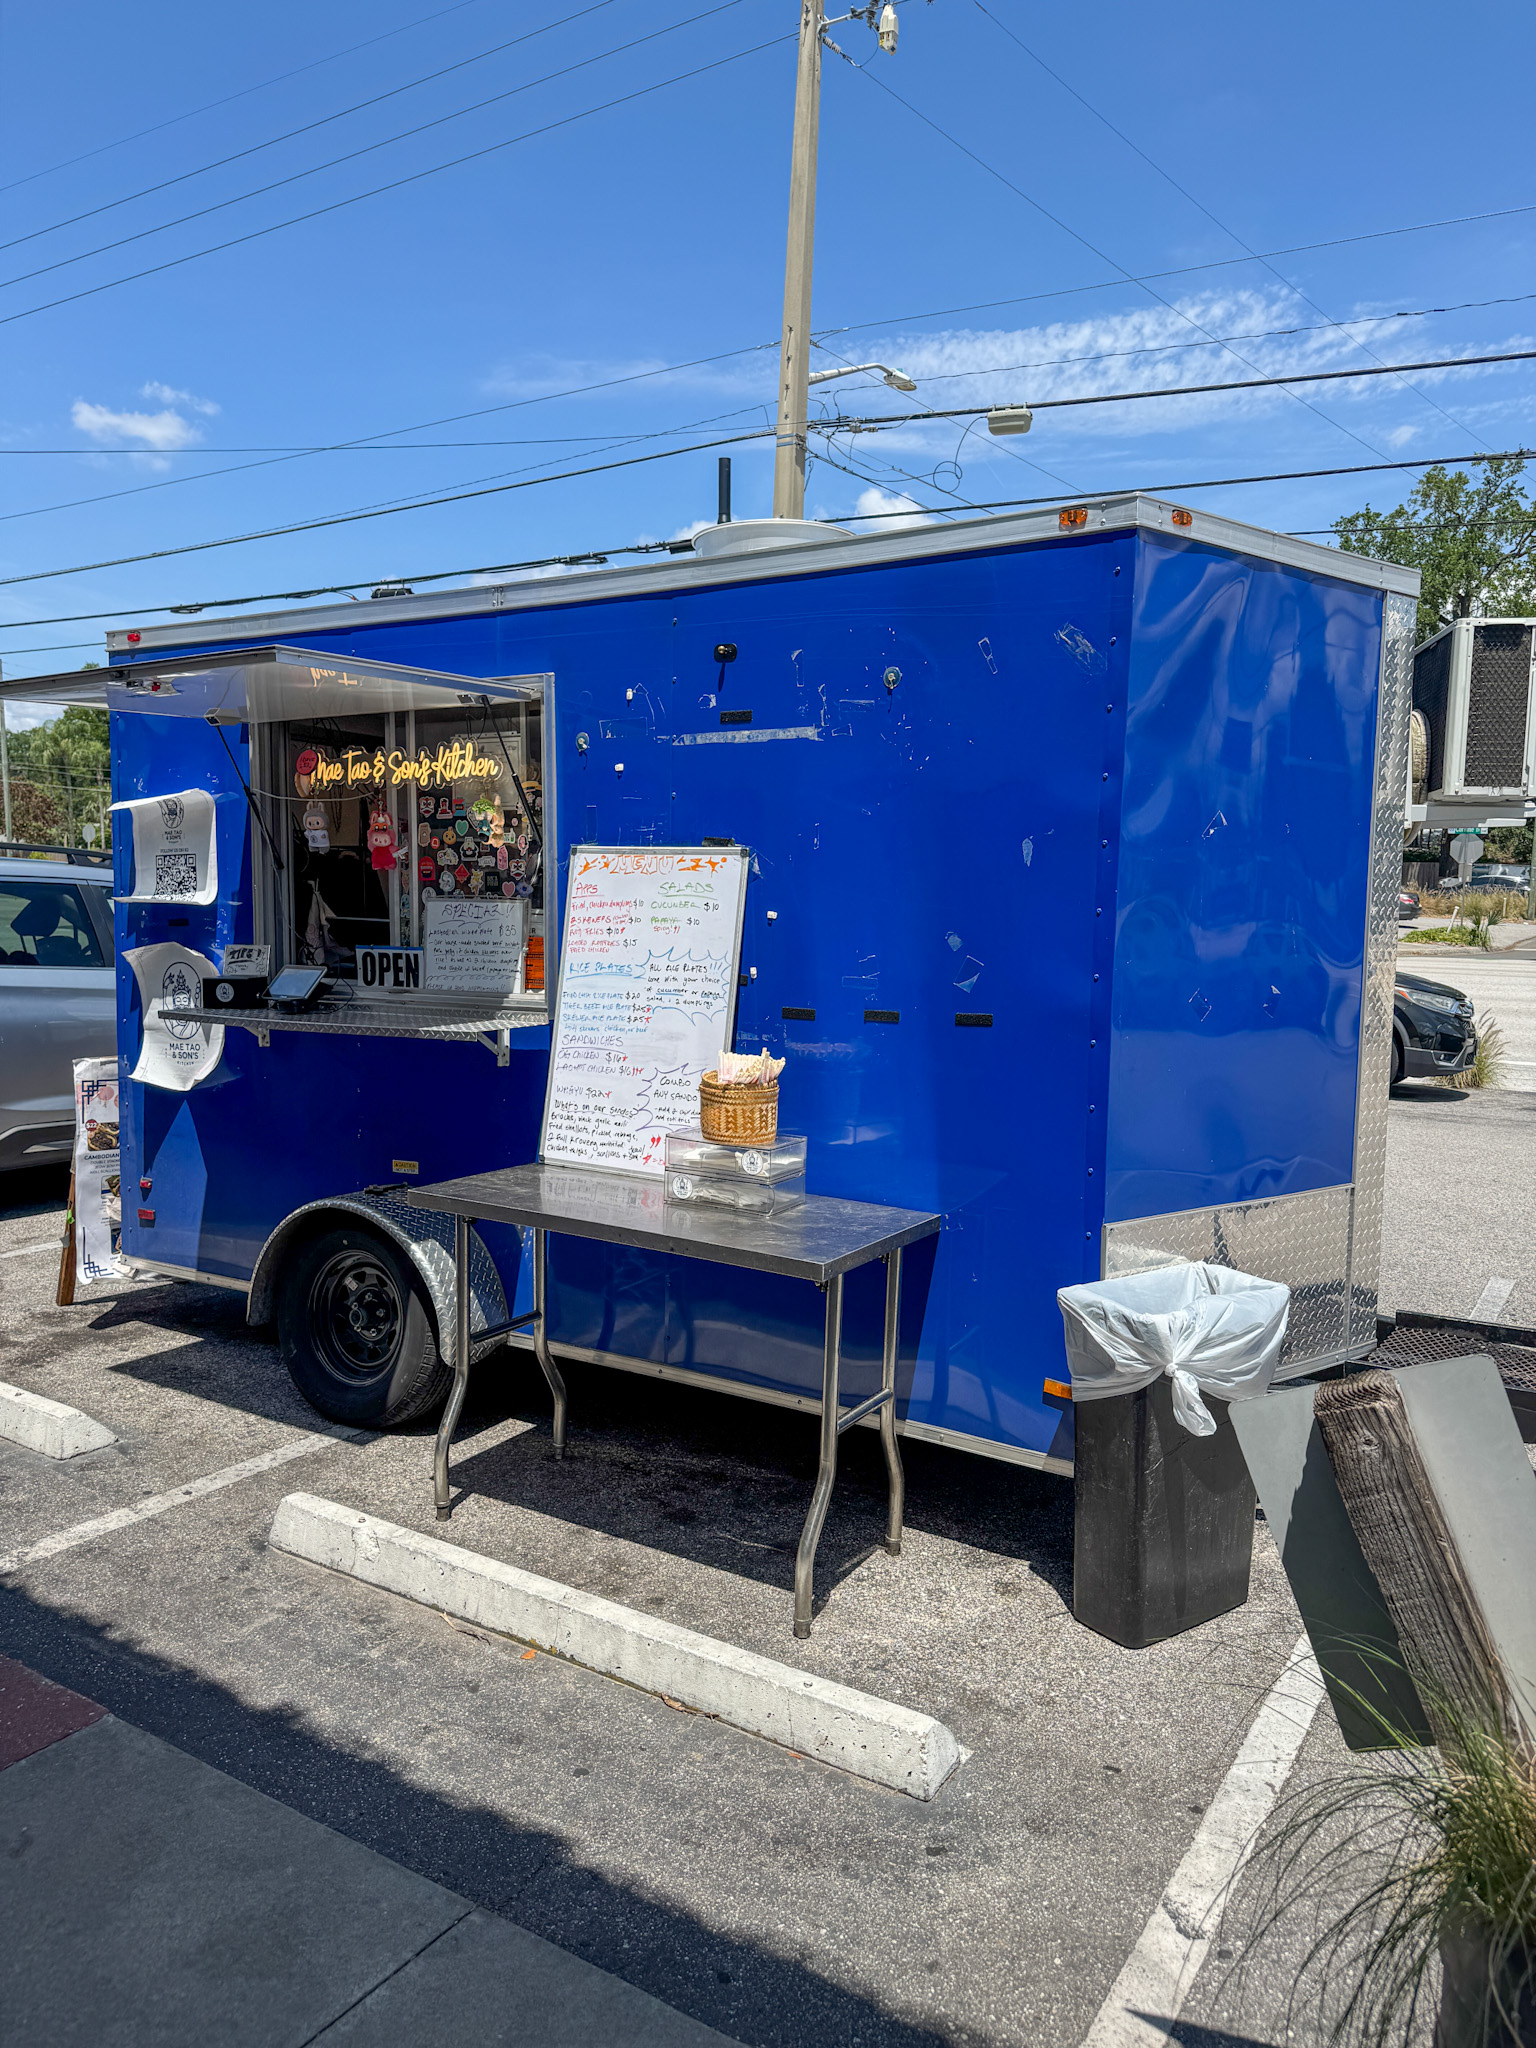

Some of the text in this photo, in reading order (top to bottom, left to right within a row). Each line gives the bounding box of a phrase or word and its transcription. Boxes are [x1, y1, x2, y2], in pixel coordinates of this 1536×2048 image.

[342, 750, 372, 785] Tao
[373, 750, 386, 784] &
[388, 750, 432, 786] Son's
[431, 742, 499, 784] Kitchen
[609, 854, 674, 876] MENU
[576, 882, 598, 895] APPS
[658, 882, 714, 894] SALADS
[633, 898, 644, 909] $10
[704, 902, 720, 912] $10
[441, 903, 504, 919] SPECIAL
[629, 916, 642, 925] $10
[651, 917, 700, 926] PAPAYA $10
[499, 924, 517, 937] $35
[606, 926, 619, 937] $10
[623, 939, 638, 948] $15
[362, 951, 419, 988] OPEN
[570, 962, 632, 974] RICE PLATES
[650, 964, 662, 972] ALL
[664, 975, 679, 983] with
[683, 978, 698, 986] your
[701, 975, 720, 984] choice
[625, 991, 640, 1000] $20
[632, 1003, 646, 1013] $25
[683, 999, 713, 1009] dumplings
[627, 1015, 644, 1024] $25
[562, 1034, 624, 1047] SANDWICHES
[169, 1043, 184, 1051] MAE
[605, 1052, 622, 1065] $16
[587, 1065, 616, 1074] CHICKEN
[619, 1066, 631, 1076] $16
[660, 1076, 691, 1086] COMBO
[586, 1088, 605, 1099] $22
[654, 1090, 697, 1102] ANY SANDO
